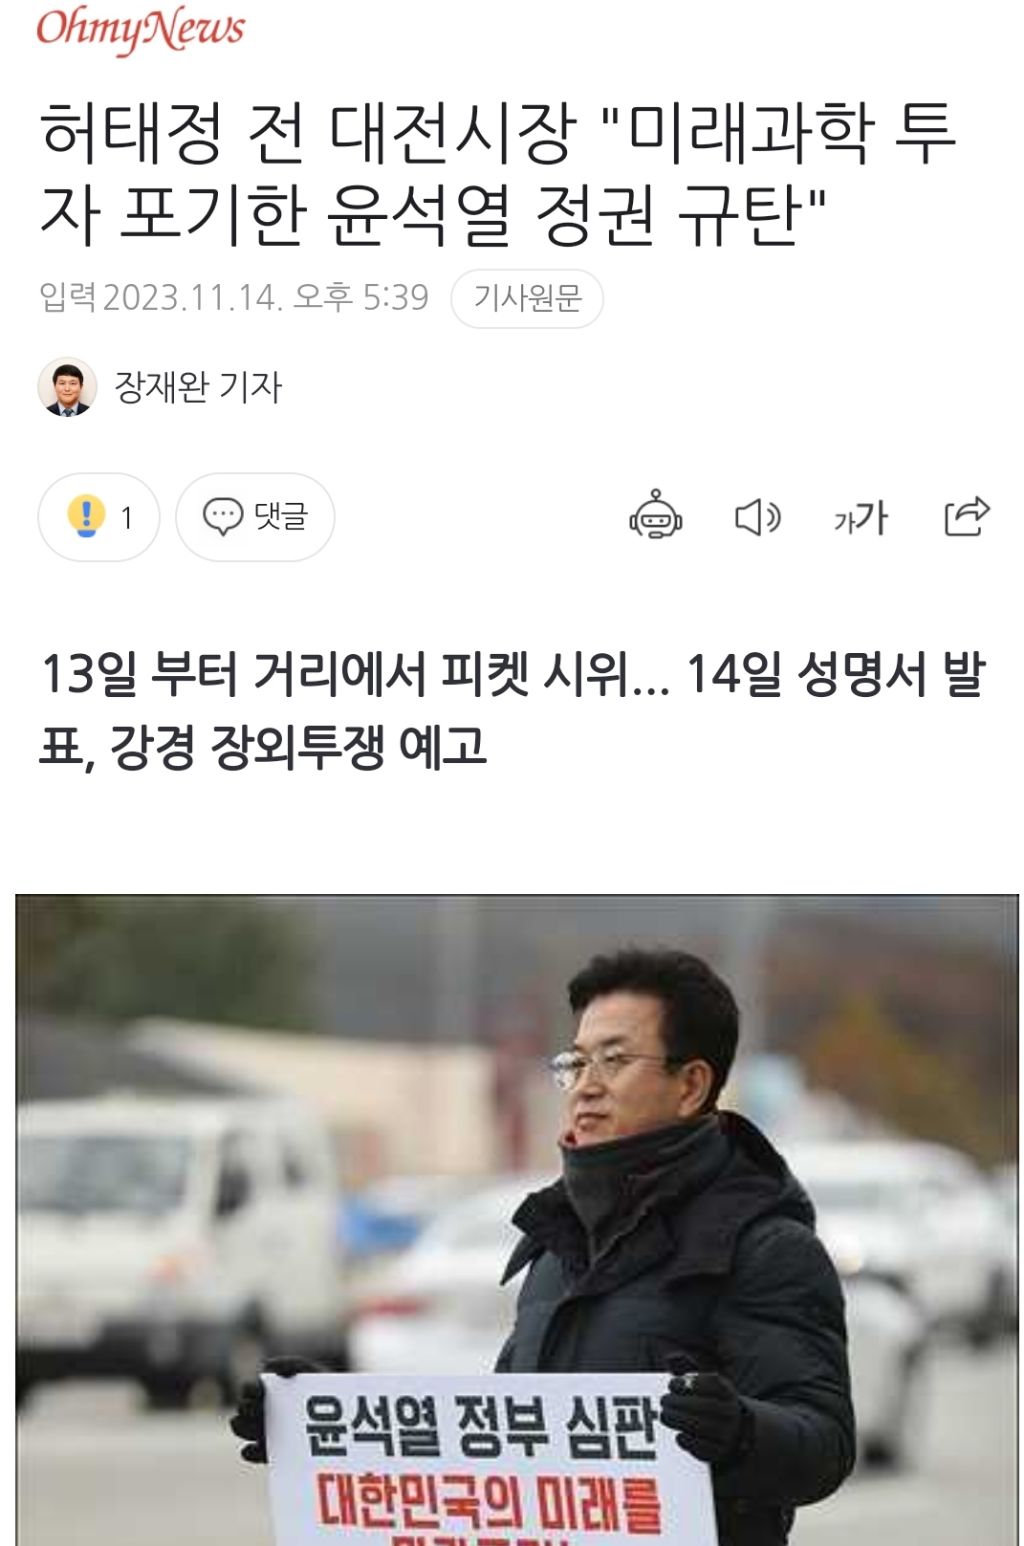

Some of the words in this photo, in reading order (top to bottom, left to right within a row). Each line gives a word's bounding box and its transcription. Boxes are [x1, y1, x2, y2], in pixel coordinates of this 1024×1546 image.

[36, 4, 247, 60] OhmyNews
[40, 100, 219, 166] 허태정
[248, 100, 303, 165] 전
[331, 100, 578, 166] 대전시장
[602, 100, 876, 166] "미래과학
[895, 102, 957, 166] 투
[40, 183, 102, 248] 자
[119, 183, 308, 248] 포기한
[327, 183, 509, 248] 윤석열
[536, 183, 653, 248] 정권
[678, 183, 826, 248] 규탄"
[40, 281, 95, 314] 입력
[103, 283, 282, 312] 2023.11.14.
[293, 281, 354, 313] 오후
[364, 283, 429, 311] 5:39
[475, 283, 583, 313] 기사원문
[114, 370, 211, 405] 장재완
[220, 370, 283, 405] 기자
[121, 505, 130, 530] 1
[254, 501, 309, 531] 댓글
[44, 650, 137, 698] 13일
[151, 650, 236, 698] 부터
[254, 650, 425, 698] 거리에서
[441, 650, 529, 698] 피켓
[543, 650, 670, 698] 시위...
[688, 650, 781, 698] 14일
[797, 650, 925, 698] 성명서
[944, 650, 987, 698] 발
[38, 726, 95, 775] 표,
[110, 723, 194, 772] 강경
[210, 723, 384, 772] 장외투쟁
[399, 723, 488, 772] 예고
[305, 1394, 441, 1458] 윤석열
[453, 1395, 550, 1459] 정부
[566, 1395, 661, 1461] 심판
[316, 1472, 521, 1531] 대한민국의
[536, 1474, 663, 1535] 미래를
